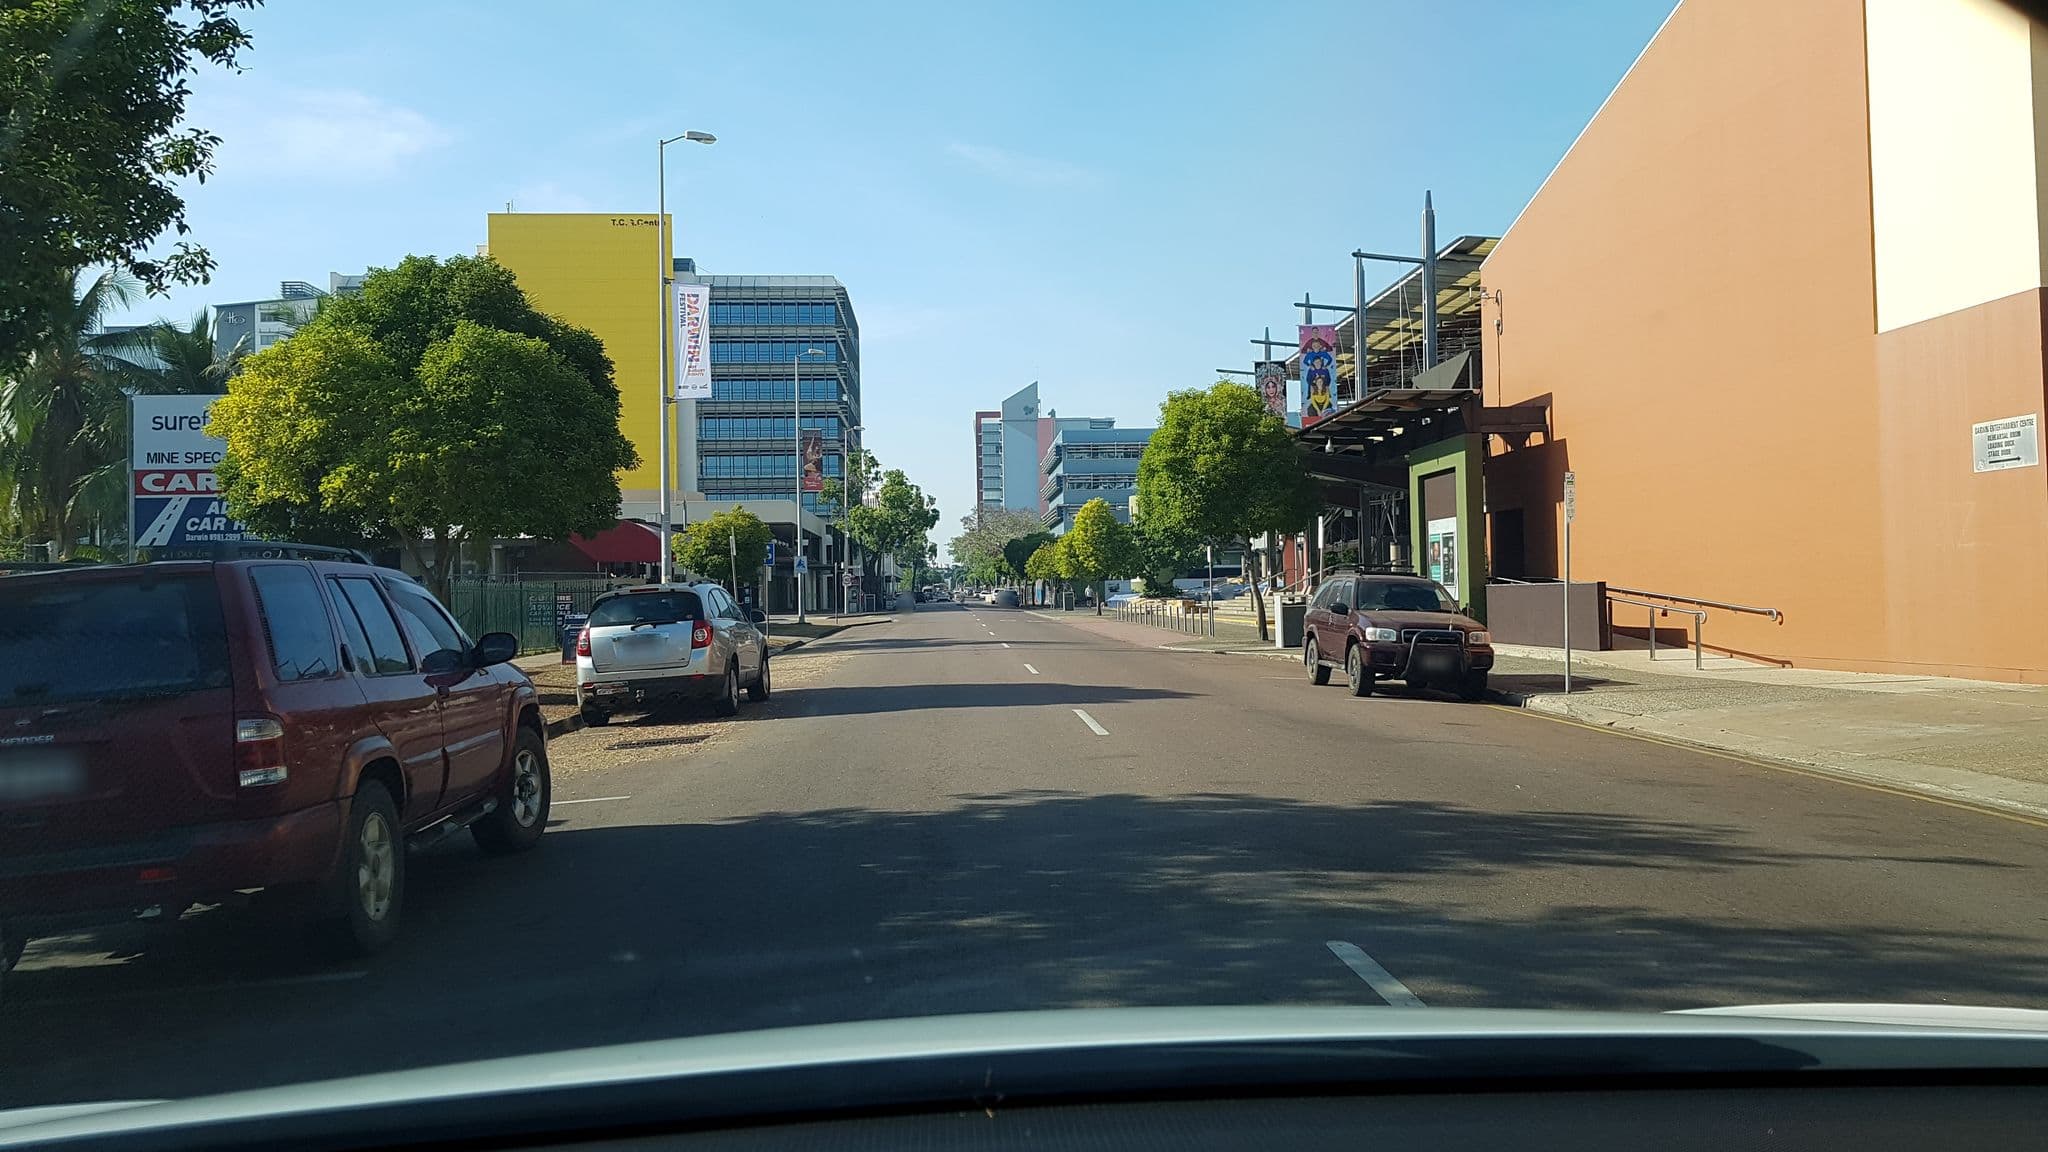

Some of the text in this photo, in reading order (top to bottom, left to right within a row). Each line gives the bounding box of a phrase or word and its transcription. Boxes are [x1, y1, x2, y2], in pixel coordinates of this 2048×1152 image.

[687, 294, 700, 362] DARWIN
[151, 410, 210, 431] suref
[146, 452, 221, 464] MINE SPEC
[186, 518, 226, 531] CAR
